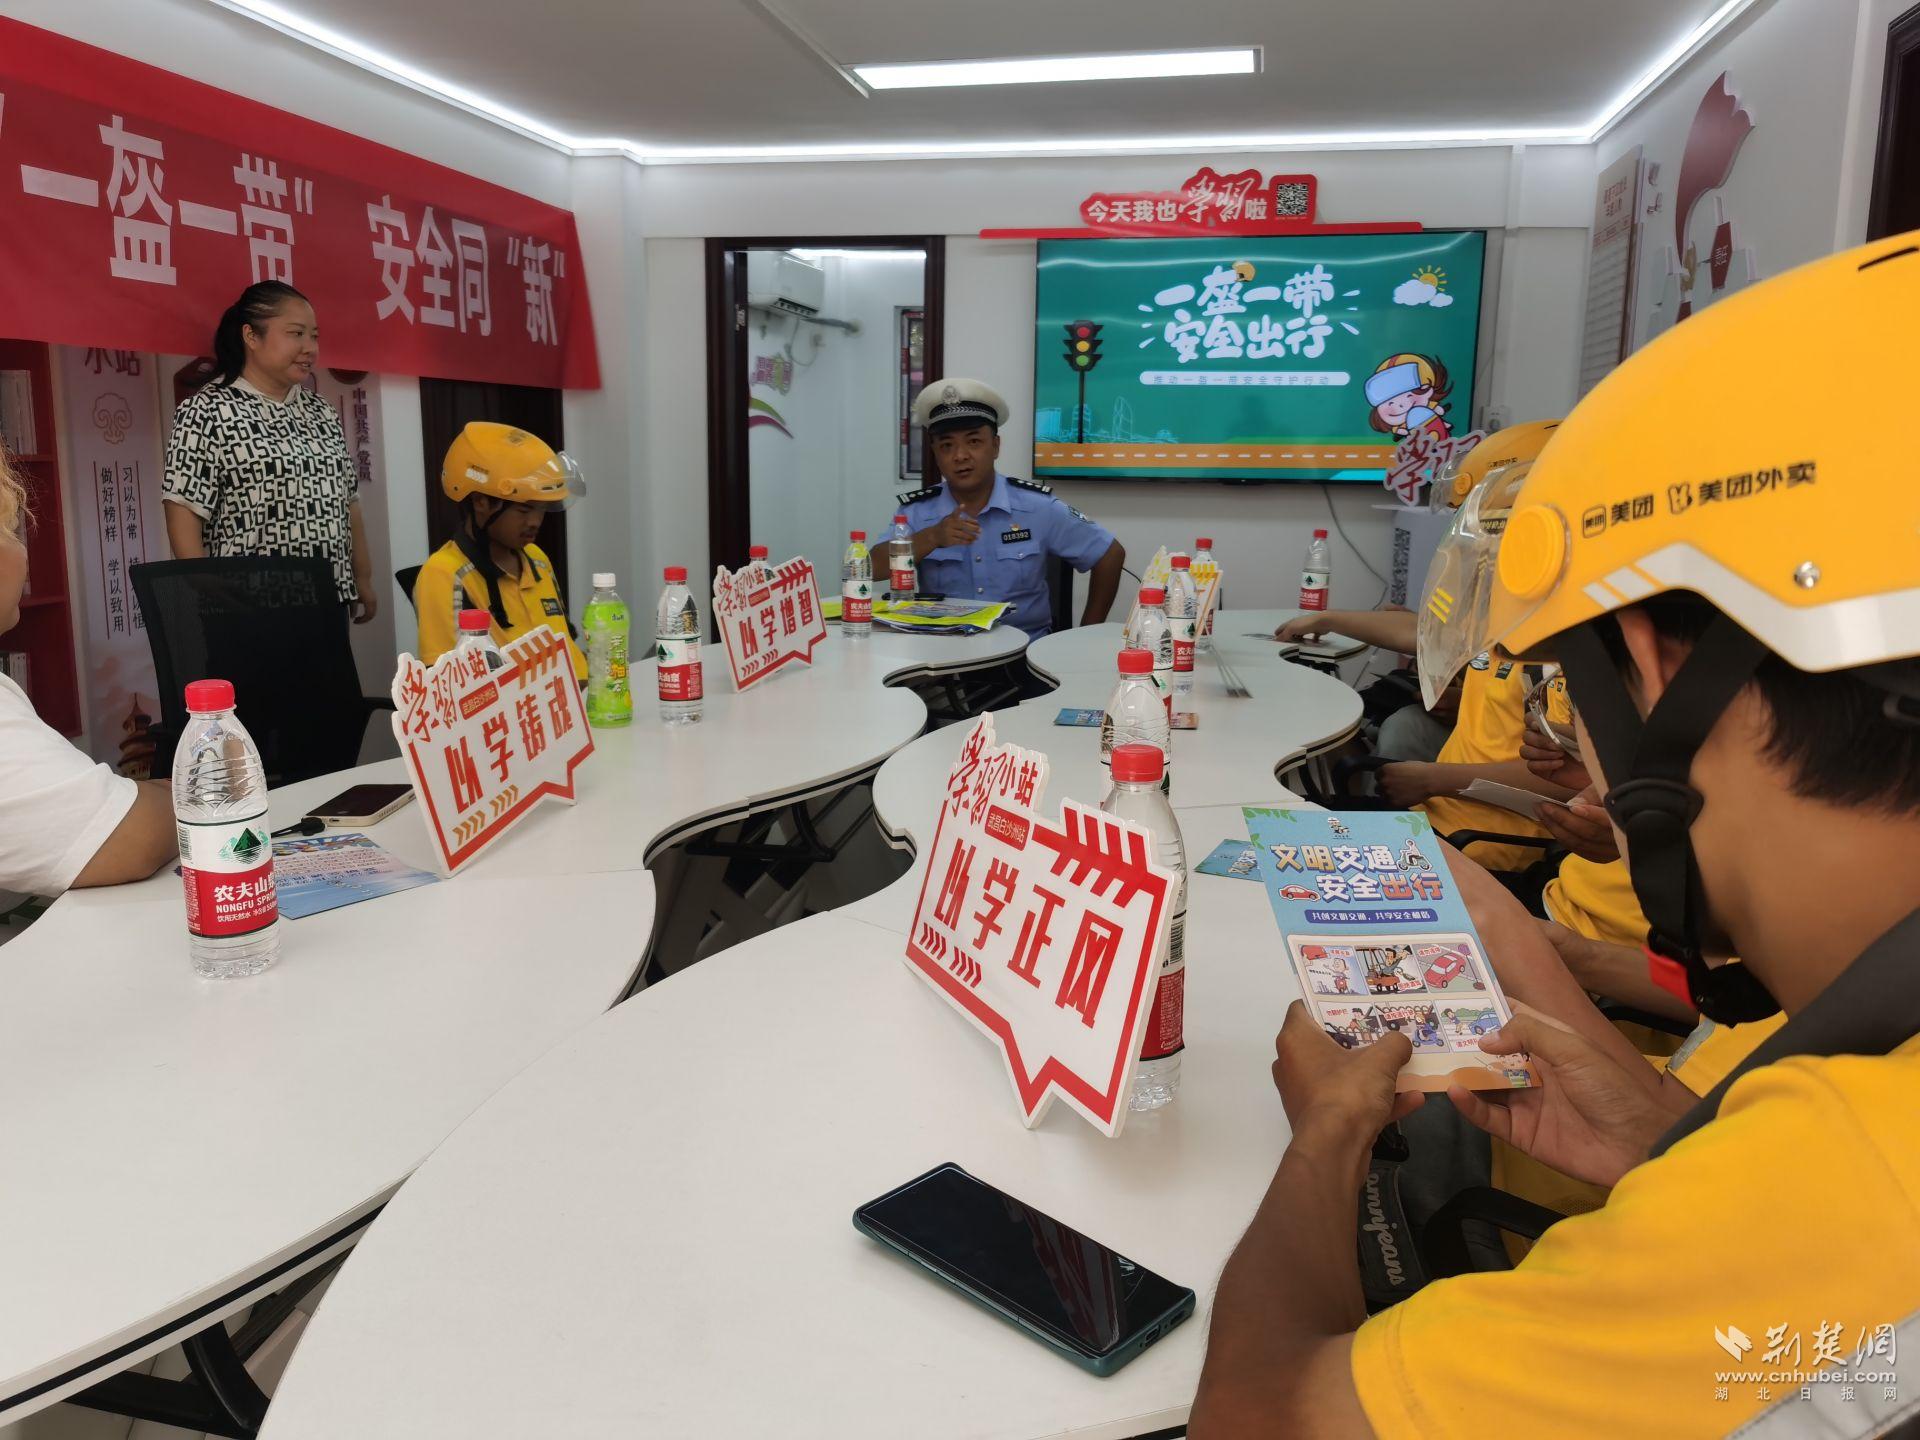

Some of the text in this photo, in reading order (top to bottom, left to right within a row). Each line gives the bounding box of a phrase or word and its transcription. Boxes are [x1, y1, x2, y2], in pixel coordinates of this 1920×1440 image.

[1154, 263, 1335, 319] 一盔一带
[1164, 308, 1333, 364] 安全出行
[101, 467, 118, 543] 做好榜样
[122, 467, 138, 541] 习以为常
[1611, 494, 1654, 526] 美团
[1699, 461, 1816, 507] 美团外卖
[1270, 843, 1396, 873] 文明交通
[216, 900, 254, 914] NONGFU
[1316, 872, 1442, 903] 安全出行
